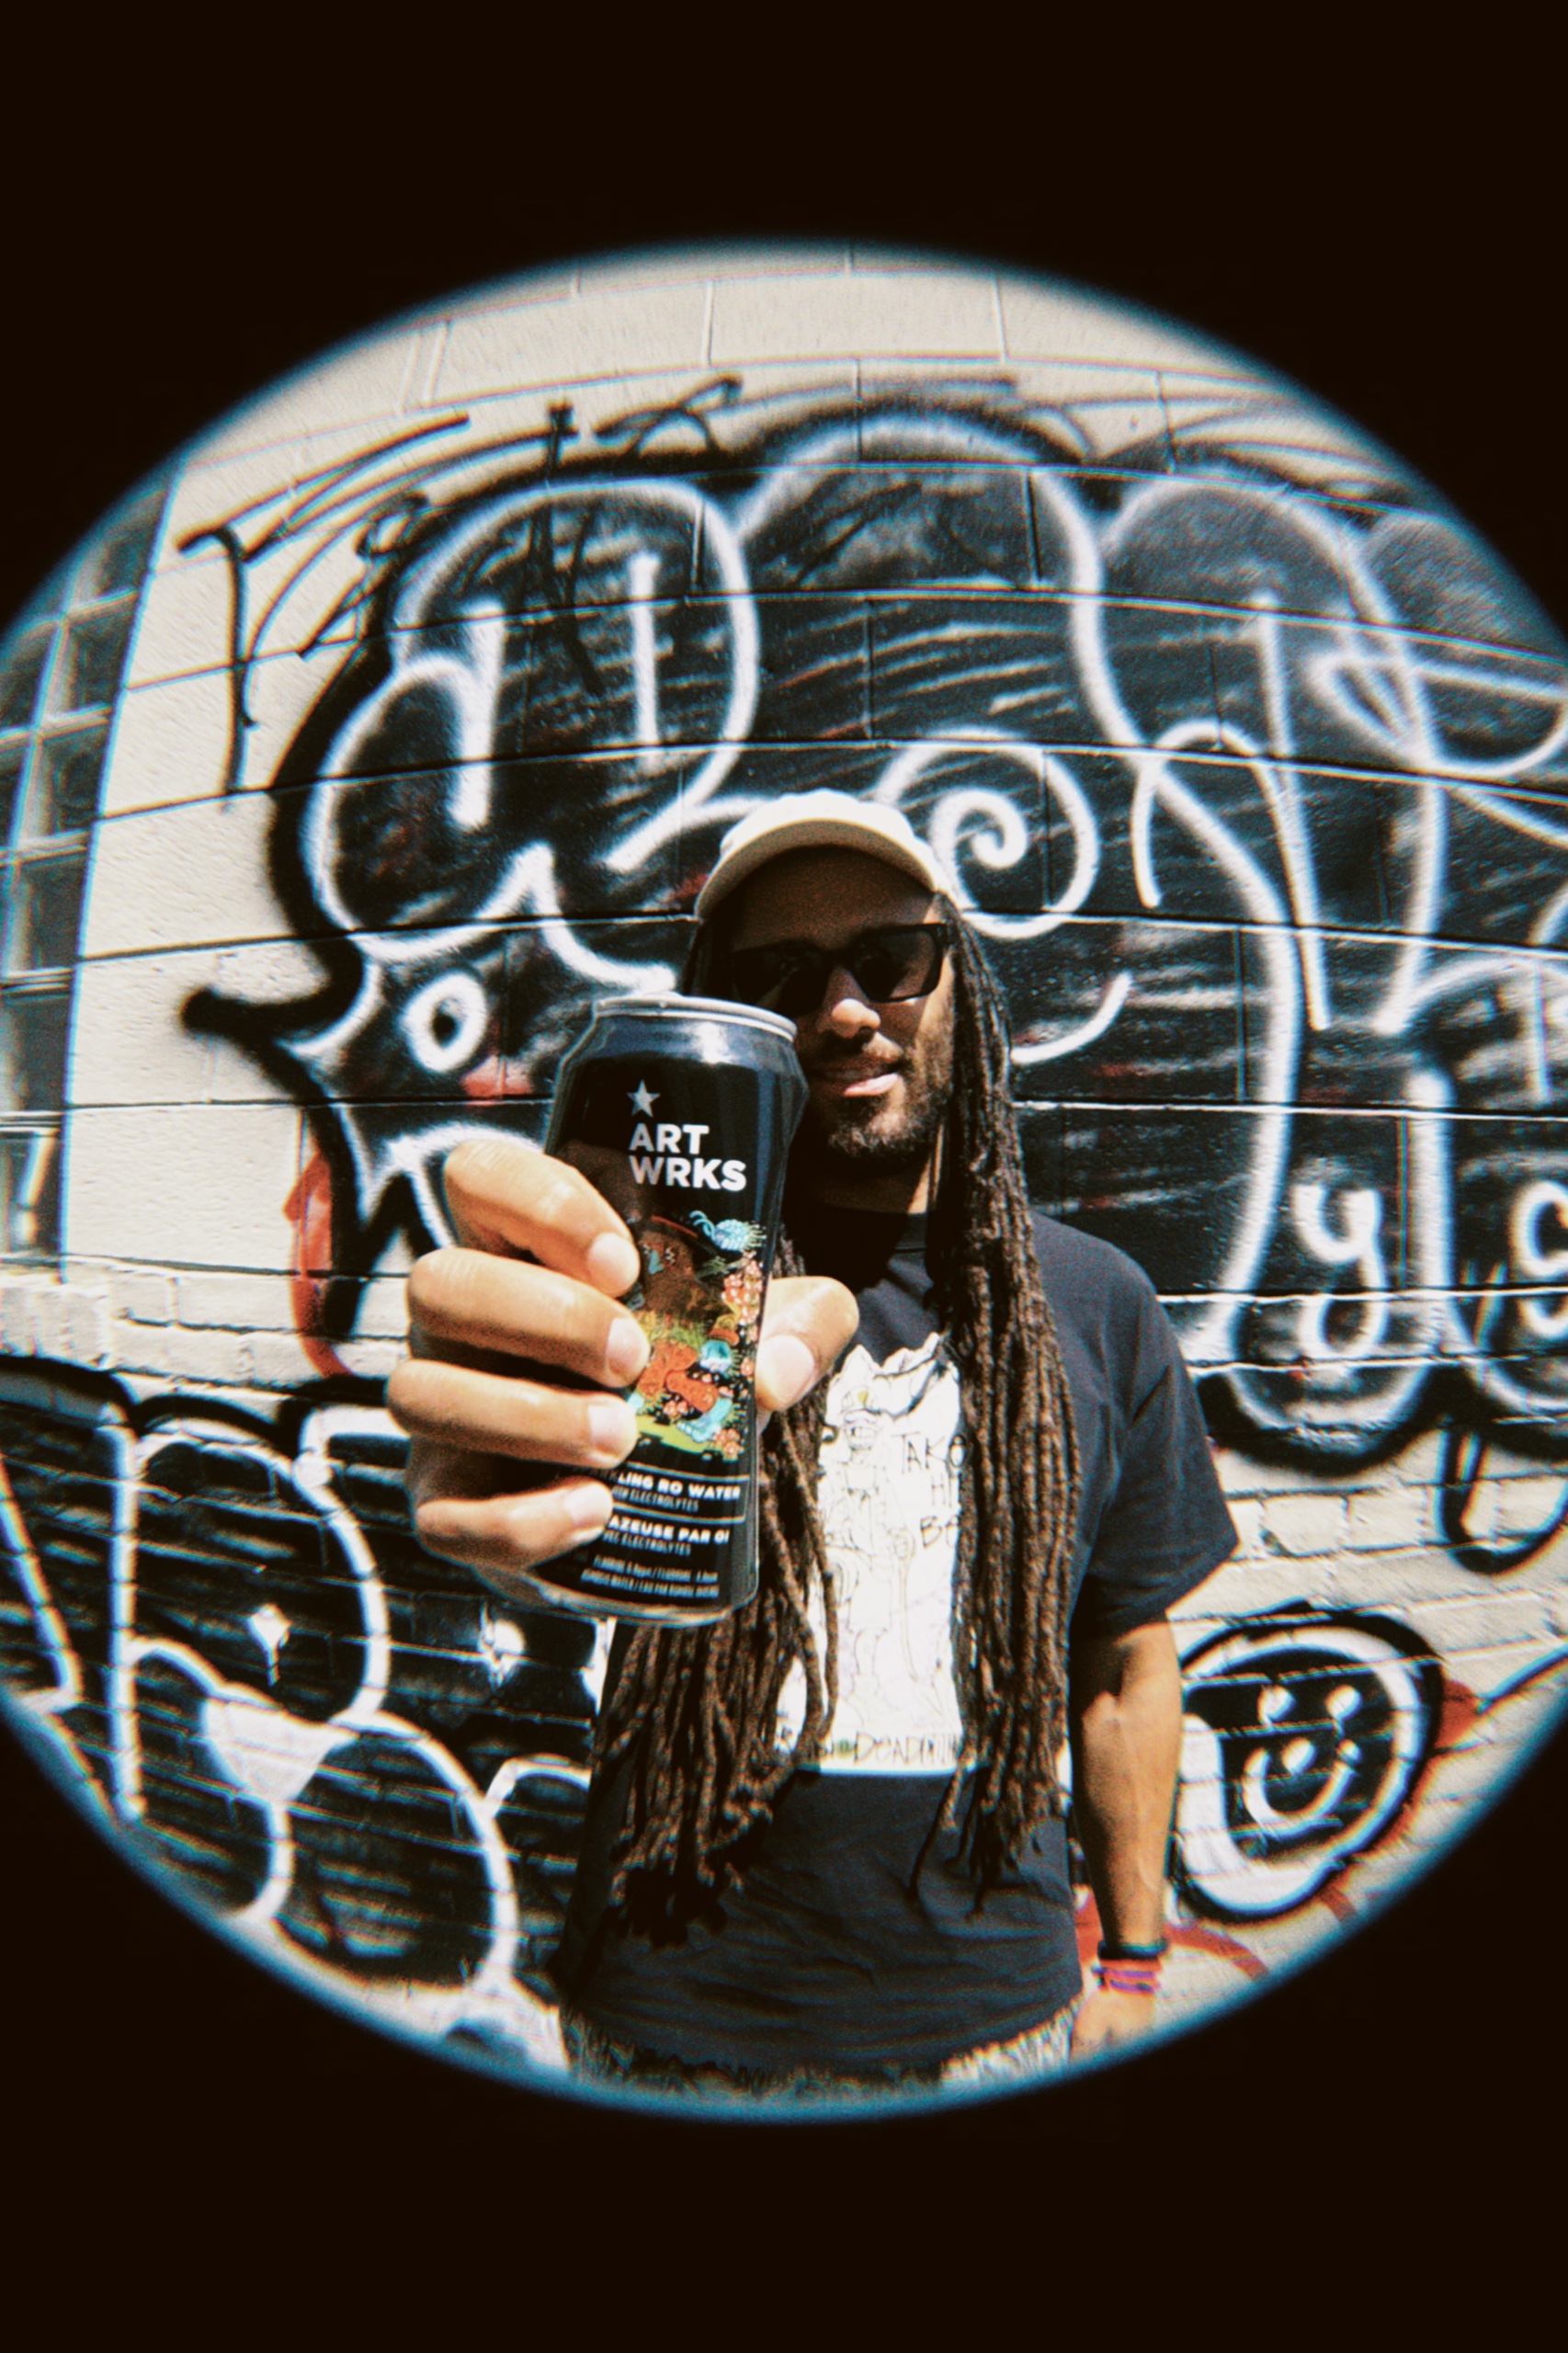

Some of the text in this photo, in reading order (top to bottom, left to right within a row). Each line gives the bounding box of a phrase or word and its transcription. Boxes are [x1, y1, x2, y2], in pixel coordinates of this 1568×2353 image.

[629, 1123, 710, 1154] ART
[629, 1155, 746, 1191] WRKS
[657, 1479, 683, 1495] RO
[688, 1483, 741, 1500] WATER
[678, 1527, 711, 1544] PAR
